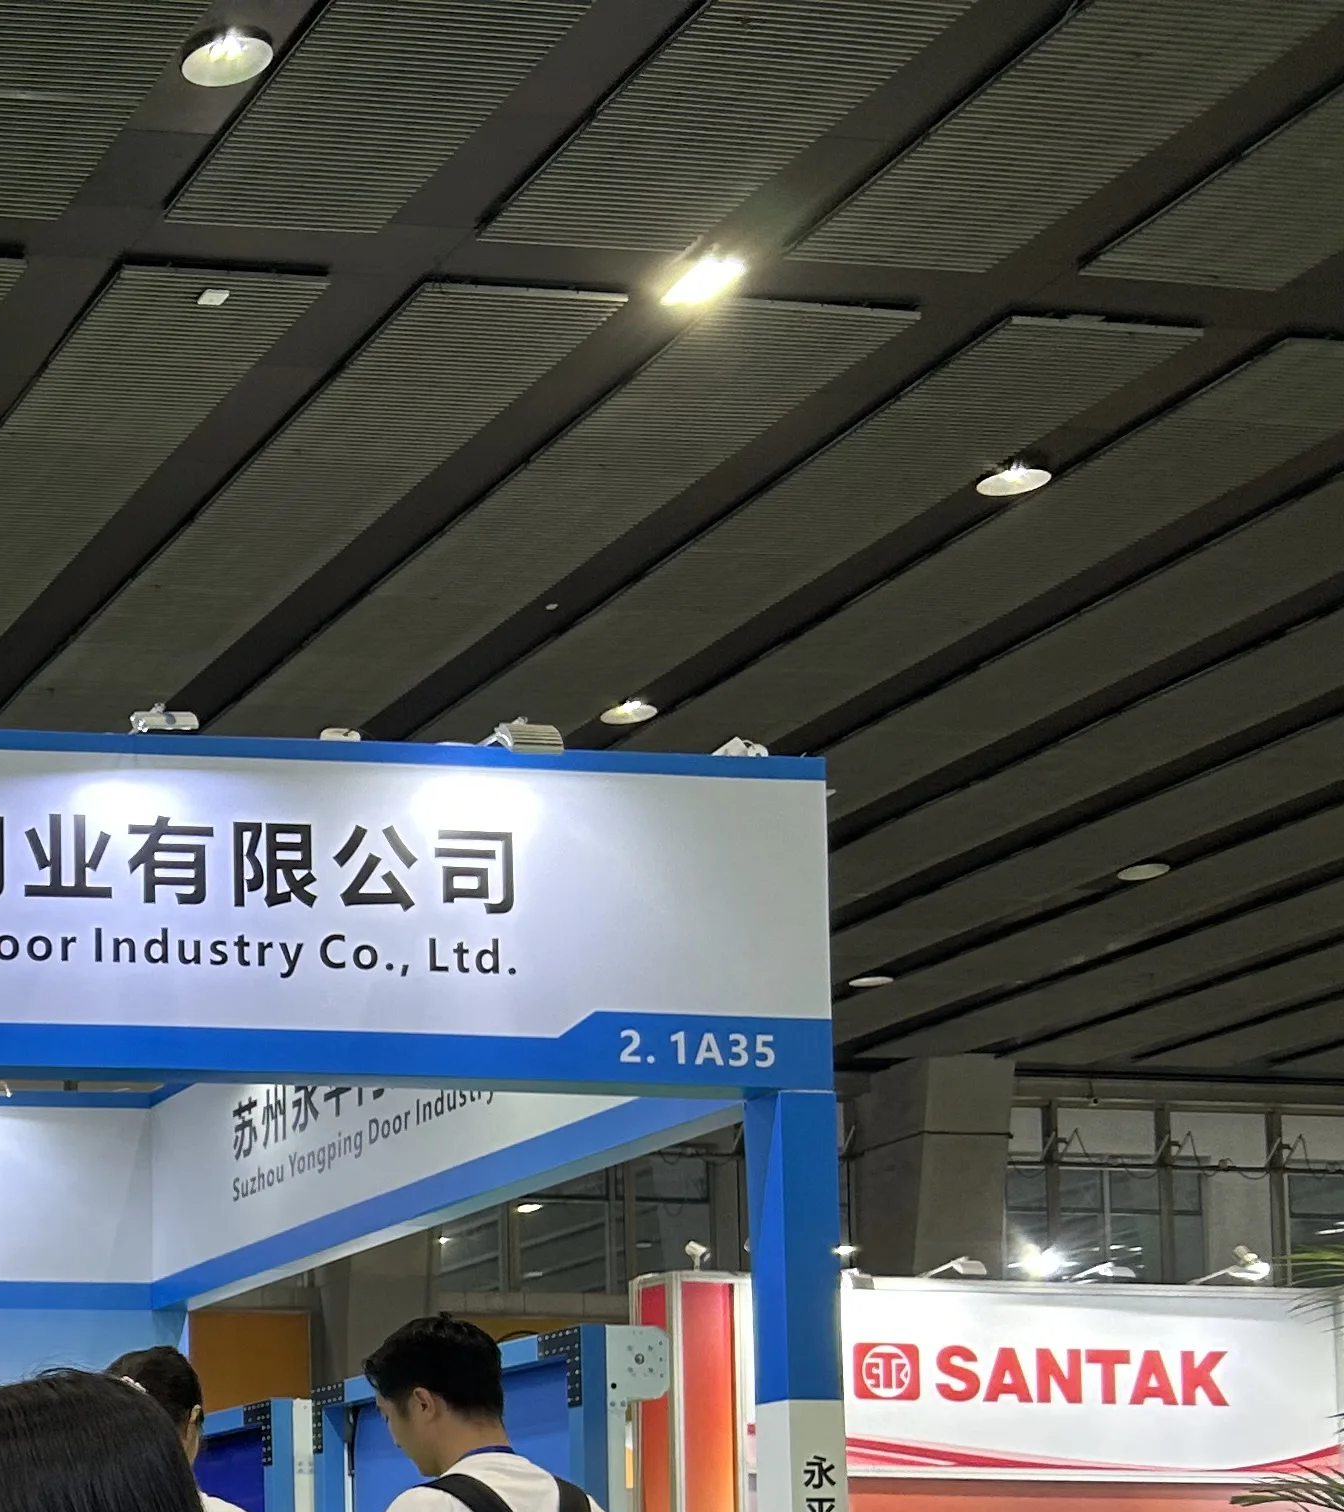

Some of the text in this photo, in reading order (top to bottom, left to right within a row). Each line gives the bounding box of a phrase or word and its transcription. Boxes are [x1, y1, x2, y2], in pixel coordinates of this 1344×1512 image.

[95, 926, 304, 978] Industry
[319, 933, 410, 977] Co.,
[429, 936, 517, 976] Ltd.
[232, 1165, 285, 1202] Suzhou
[288, 1130, 363, 1178] Yongping
[368, 1109, 411, 1146] Door
[934, 1344, 1230, 1407] SANTAK
